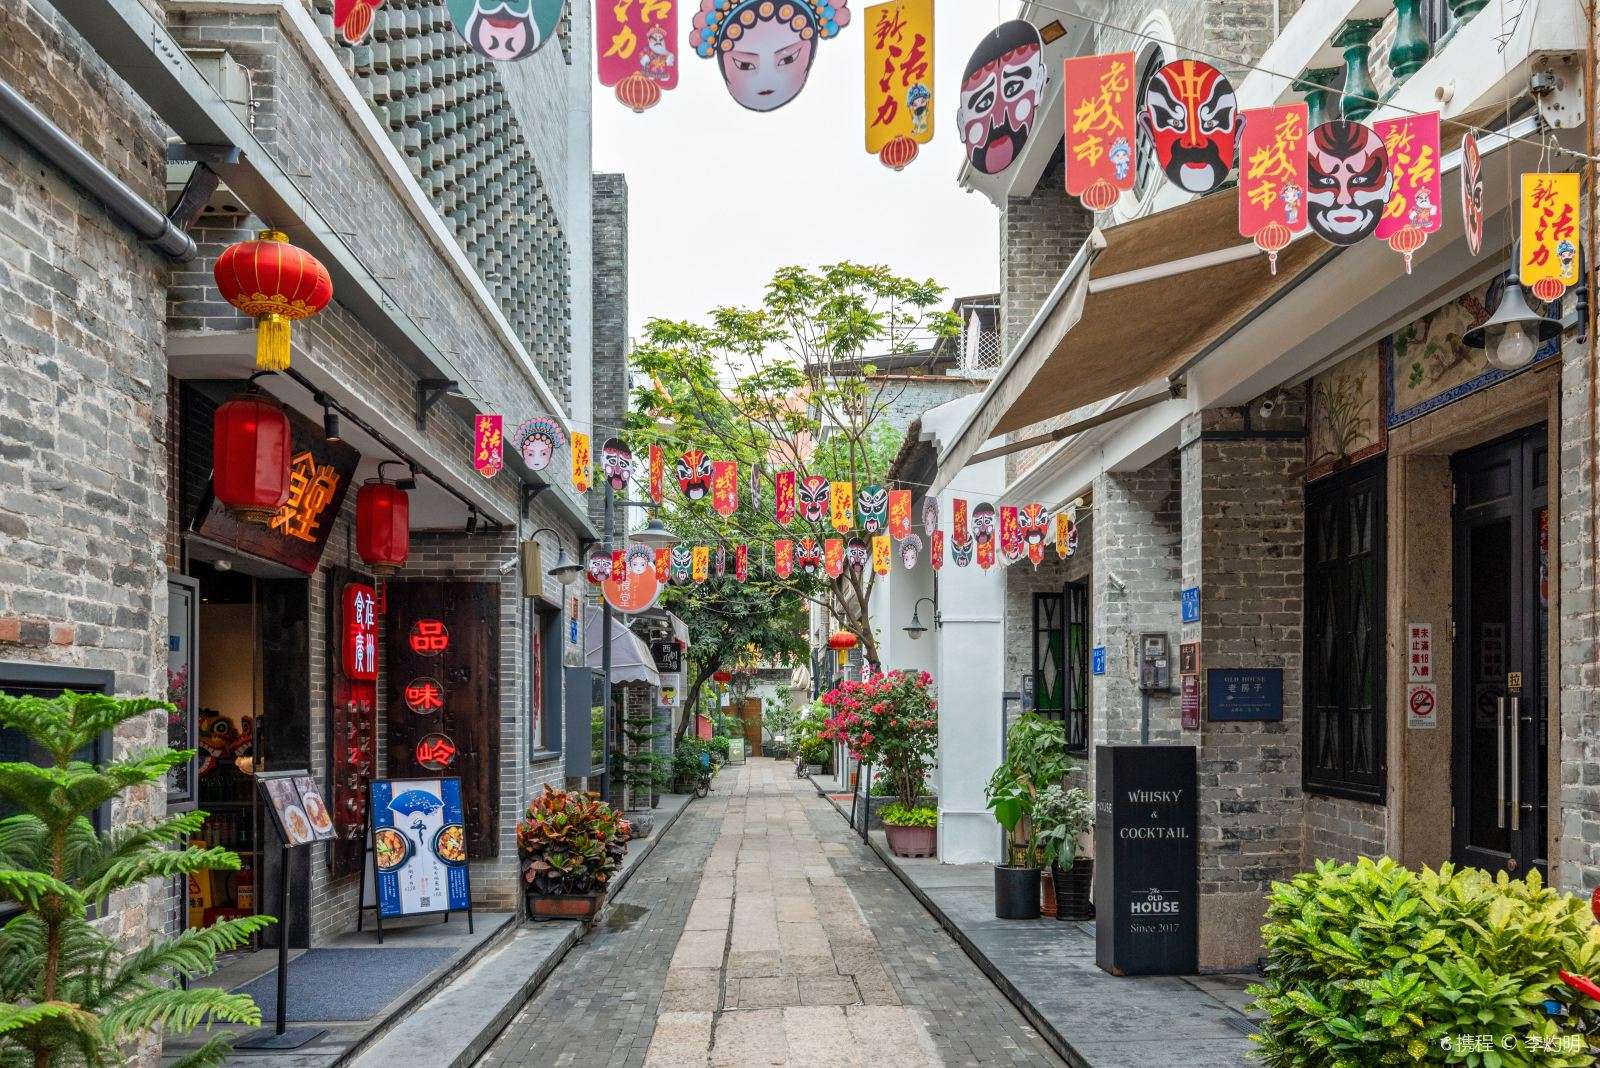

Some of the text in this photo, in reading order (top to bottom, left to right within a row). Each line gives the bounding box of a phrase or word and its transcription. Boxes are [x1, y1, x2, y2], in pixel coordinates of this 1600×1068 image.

[1128, 789, 1183, 803] WHISKY
[1151, 810, 1158, 819] &
[1120, 827, 1189, 839] COCKTAIL
[1147, 894, 1163, 902] OLD
[1130, 901, 1180, 913] HOUSE
[1130, 923, 1180, 933] Since 2017
